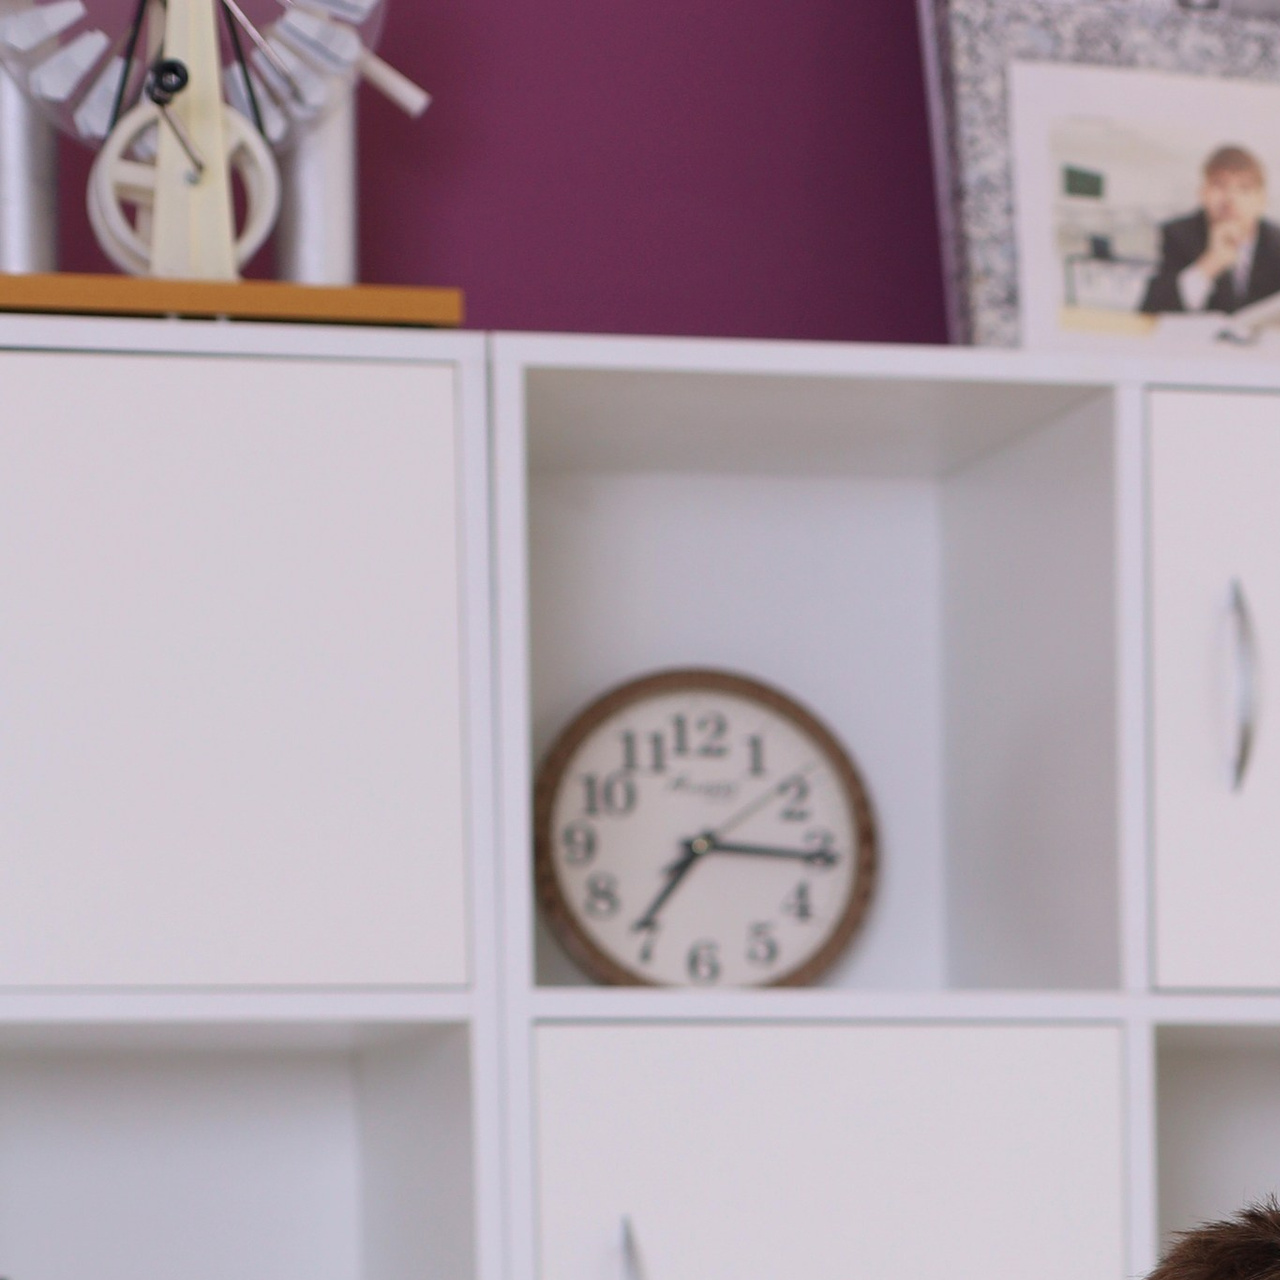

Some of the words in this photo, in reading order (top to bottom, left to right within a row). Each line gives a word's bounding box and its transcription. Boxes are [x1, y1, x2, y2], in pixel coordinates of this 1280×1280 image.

[621, 730, 665, 773] 11
[672, 712, 731, 758] 12
[749, 734, 764, 776] 1
[583, 771, 637, 818] 10
[777, 775, 809, 821] 2
[562, 822, 595, 866] 9
[584, 871, 620, 918] 8
[781, 881, 811, 921] 4
[687, 939, 721, 984] 6
[747, 922, 778, 964] 5
